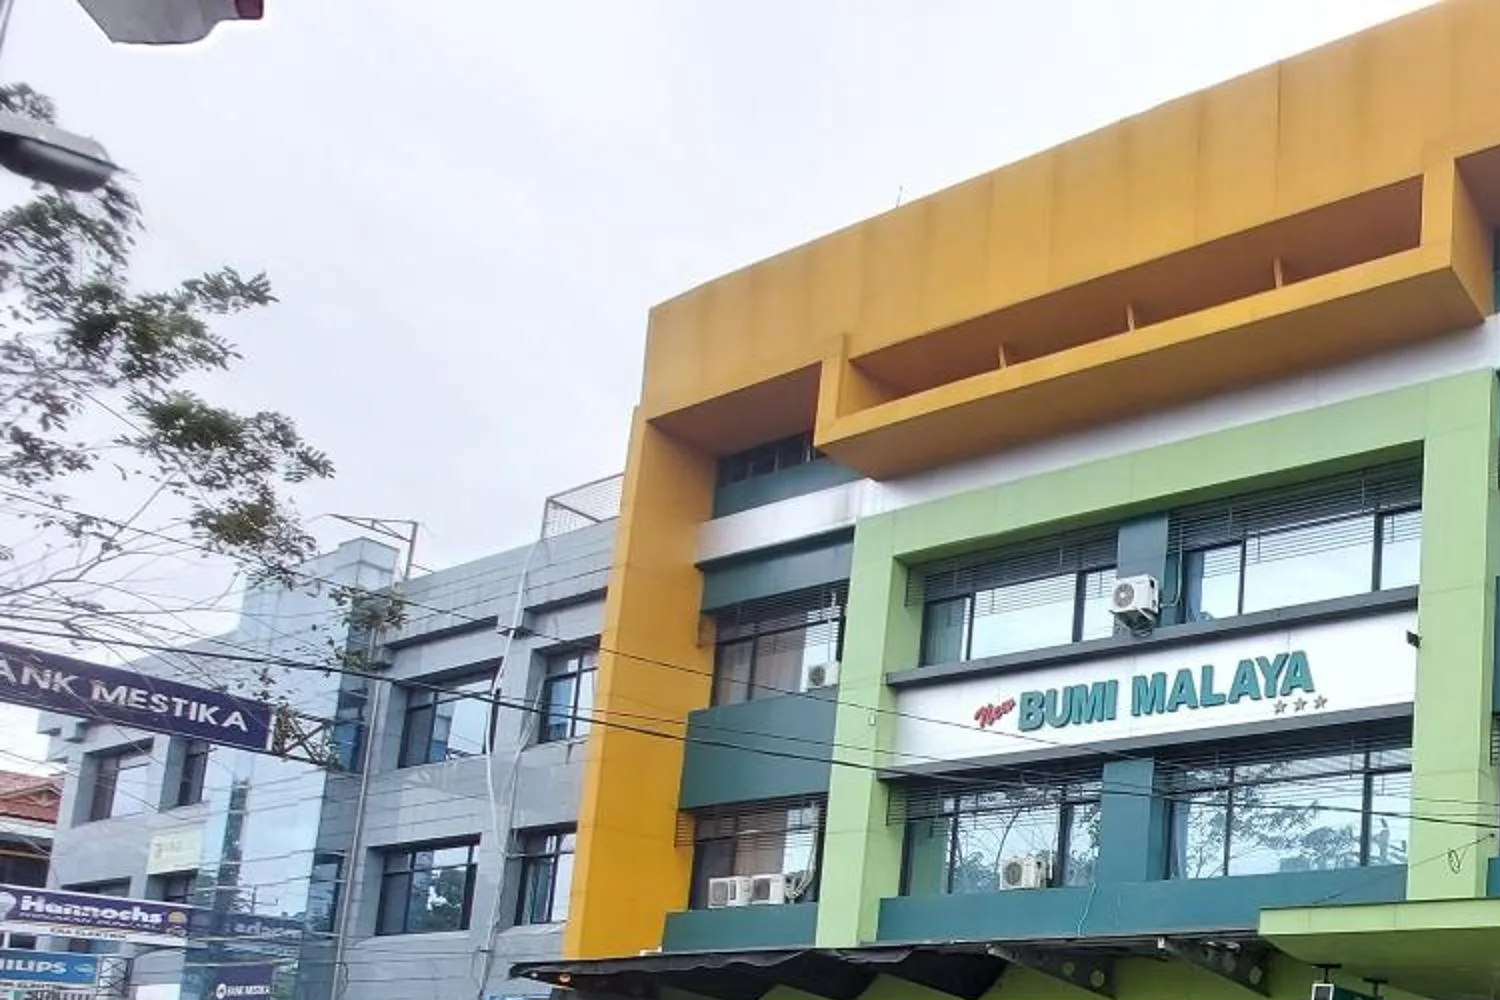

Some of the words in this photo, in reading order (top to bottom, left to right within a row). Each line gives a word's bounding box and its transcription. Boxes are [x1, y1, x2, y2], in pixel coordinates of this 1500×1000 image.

[0, 658, 78, 694] ANK
[90, 679, 248, 732] MESTIKA
[974, 698, 1016, 728] New
[1018, 679, 1119, 732] BUMI
[1131, 650, 1316, 717] MALAYA
[20, 895, 163, 924] Hannochs
